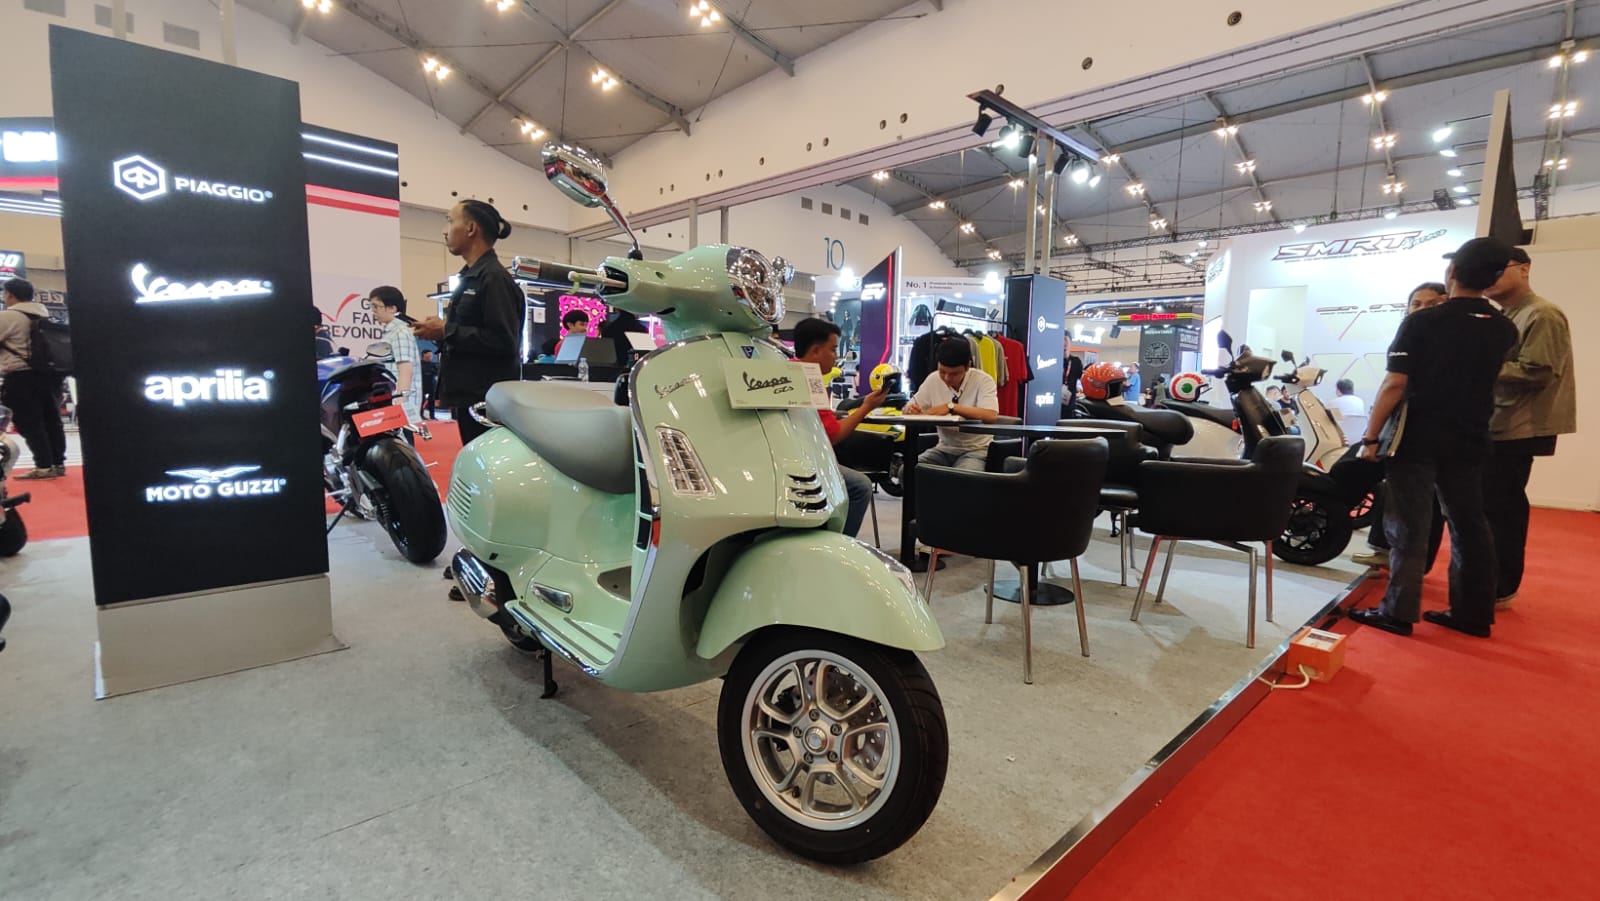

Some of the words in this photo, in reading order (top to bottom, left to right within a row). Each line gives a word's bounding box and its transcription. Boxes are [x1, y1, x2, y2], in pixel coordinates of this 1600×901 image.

[174, 177, 265, 202] PIAGGIO
[824, 237, 845, 271] 10
[1272, 230, 1423, 261] SMRT
[131, 263, 273, 304] Vespa
[145, 369, 270, 407] aprilia
[742, 371, 793, 392] Vespa
[146, 484, 211, 502] MOTO
[217, 479, 281, 497] GUZZI
